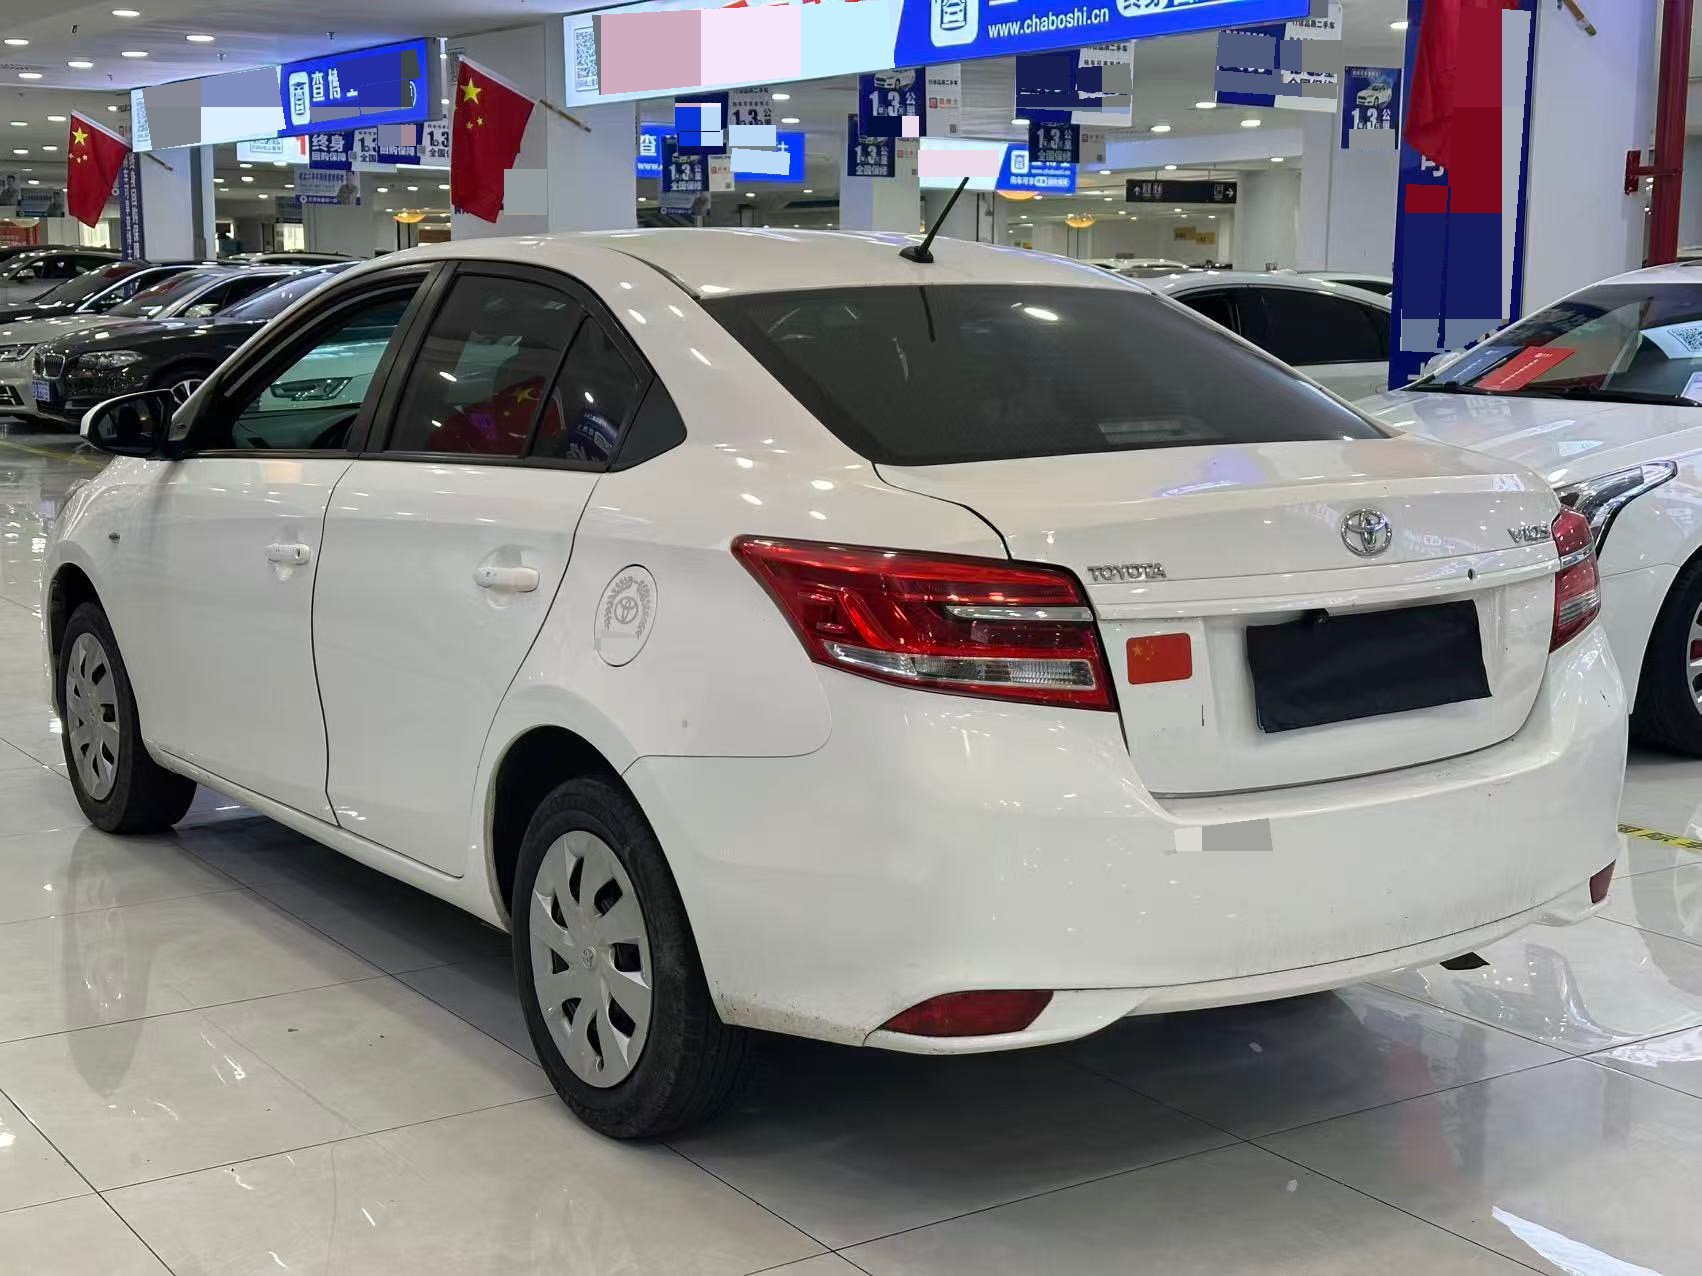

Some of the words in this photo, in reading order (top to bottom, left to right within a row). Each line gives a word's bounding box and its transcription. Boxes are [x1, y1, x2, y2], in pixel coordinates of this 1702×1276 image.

[988, 6, 1109, 39] www.chaboshi.cn
[312, 134, 345, 152] 终身
[1507, 524, 1550, 544] VIOS
[1087, 563, 1167, 582] TOYOTA
